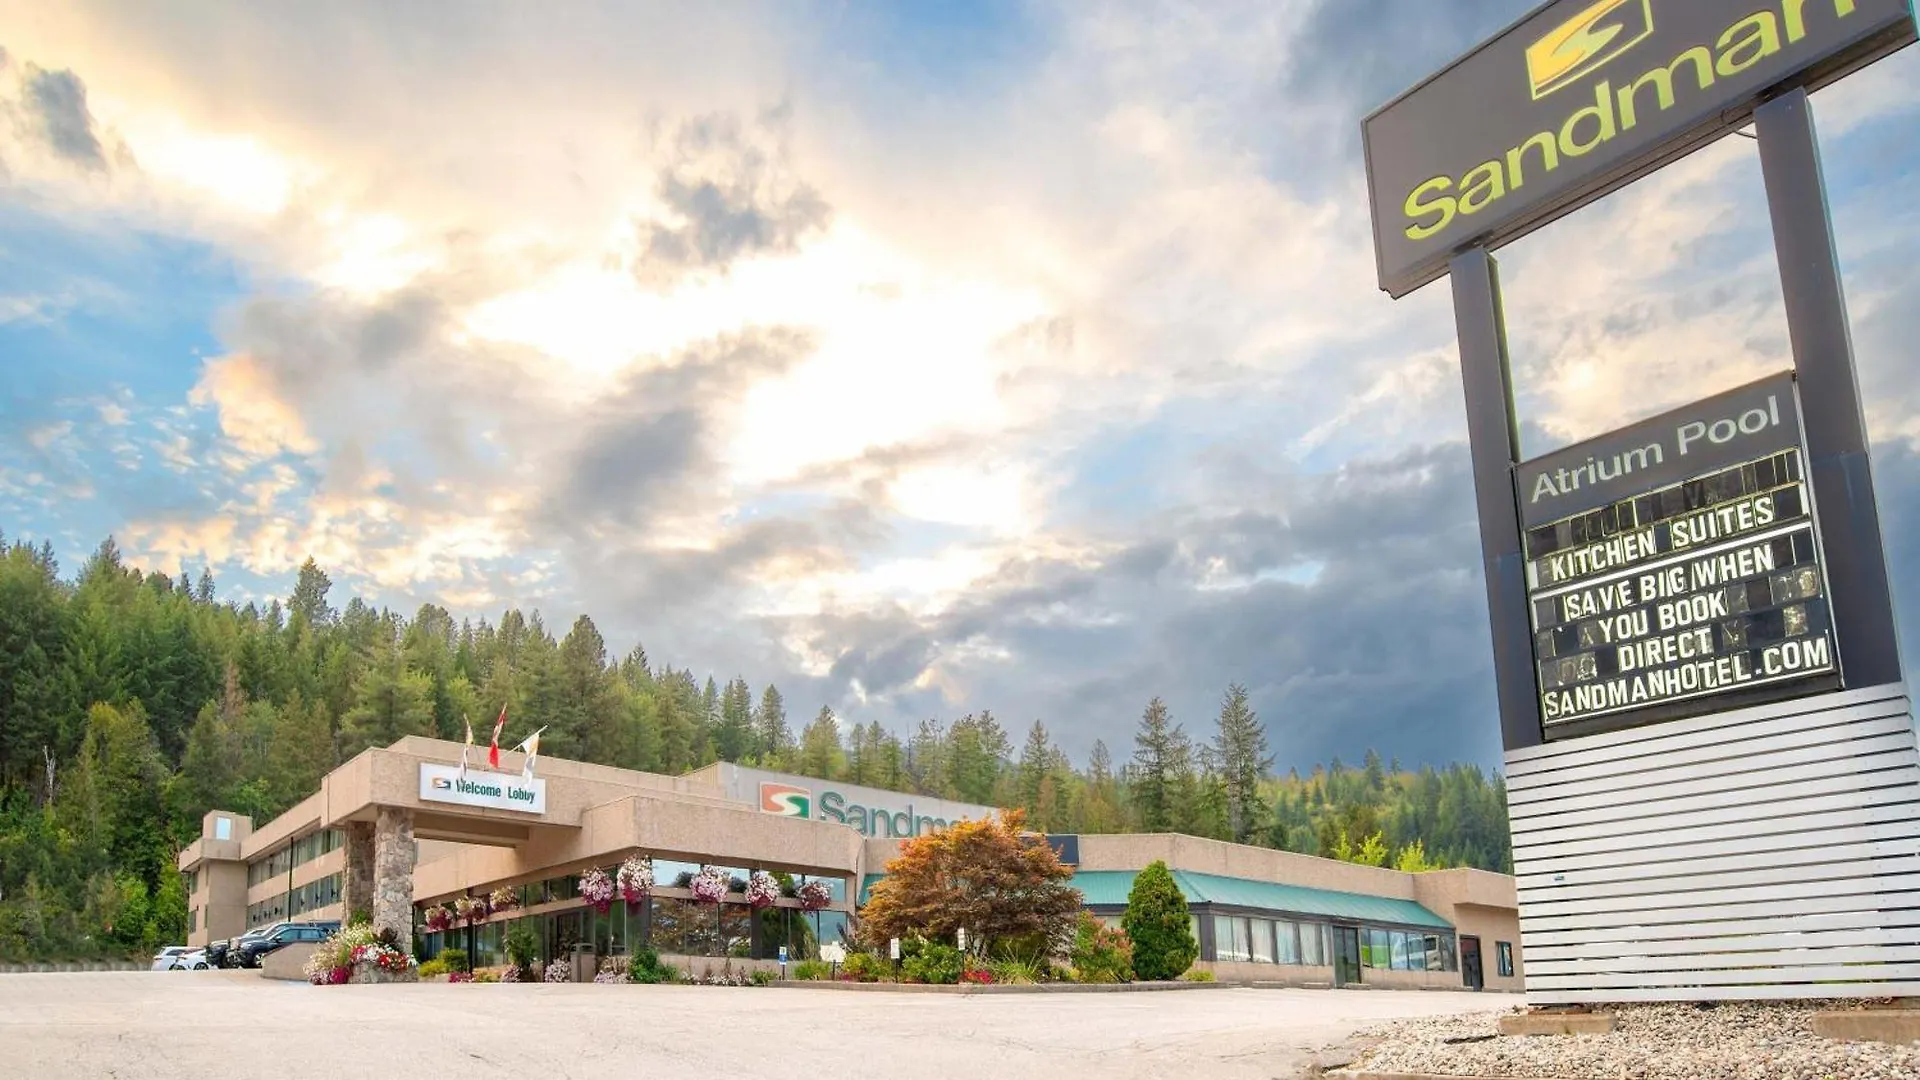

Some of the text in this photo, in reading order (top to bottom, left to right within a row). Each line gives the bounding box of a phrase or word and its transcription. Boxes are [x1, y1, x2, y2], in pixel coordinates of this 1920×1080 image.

[1531, 395, 1780, 502] Atrium Pool
[1551, 497, 1774, 582] KITCHEN SUITES
[1565, 544, 1774, 620] SAVE BIG WHEN
[1599, 590, 1727, 643] YOU BOOK
[1545, 638, 1829, 716] SANDMANHOTEL.COM
[1618, 628, 1712, 672] DIRECT
[456, 779, 501, 797] Welcome
[819, 791, 963, 837] Sandm
